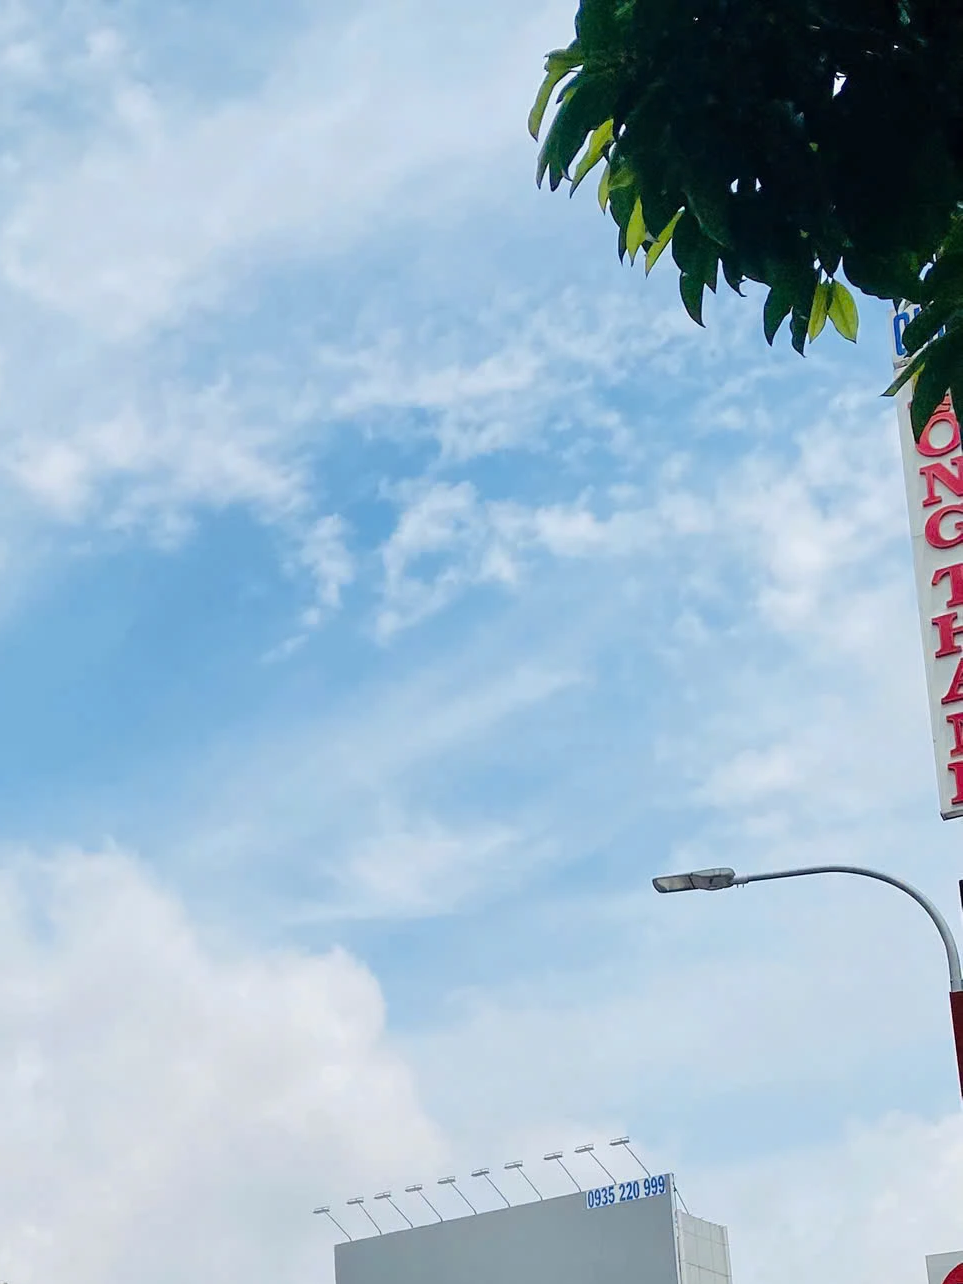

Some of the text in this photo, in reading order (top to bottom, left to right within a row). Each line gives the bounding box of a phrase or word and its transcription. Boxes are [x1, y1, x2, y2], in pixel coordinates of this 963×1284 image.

[588, 1175, 665, 1208] 0935 220 999
